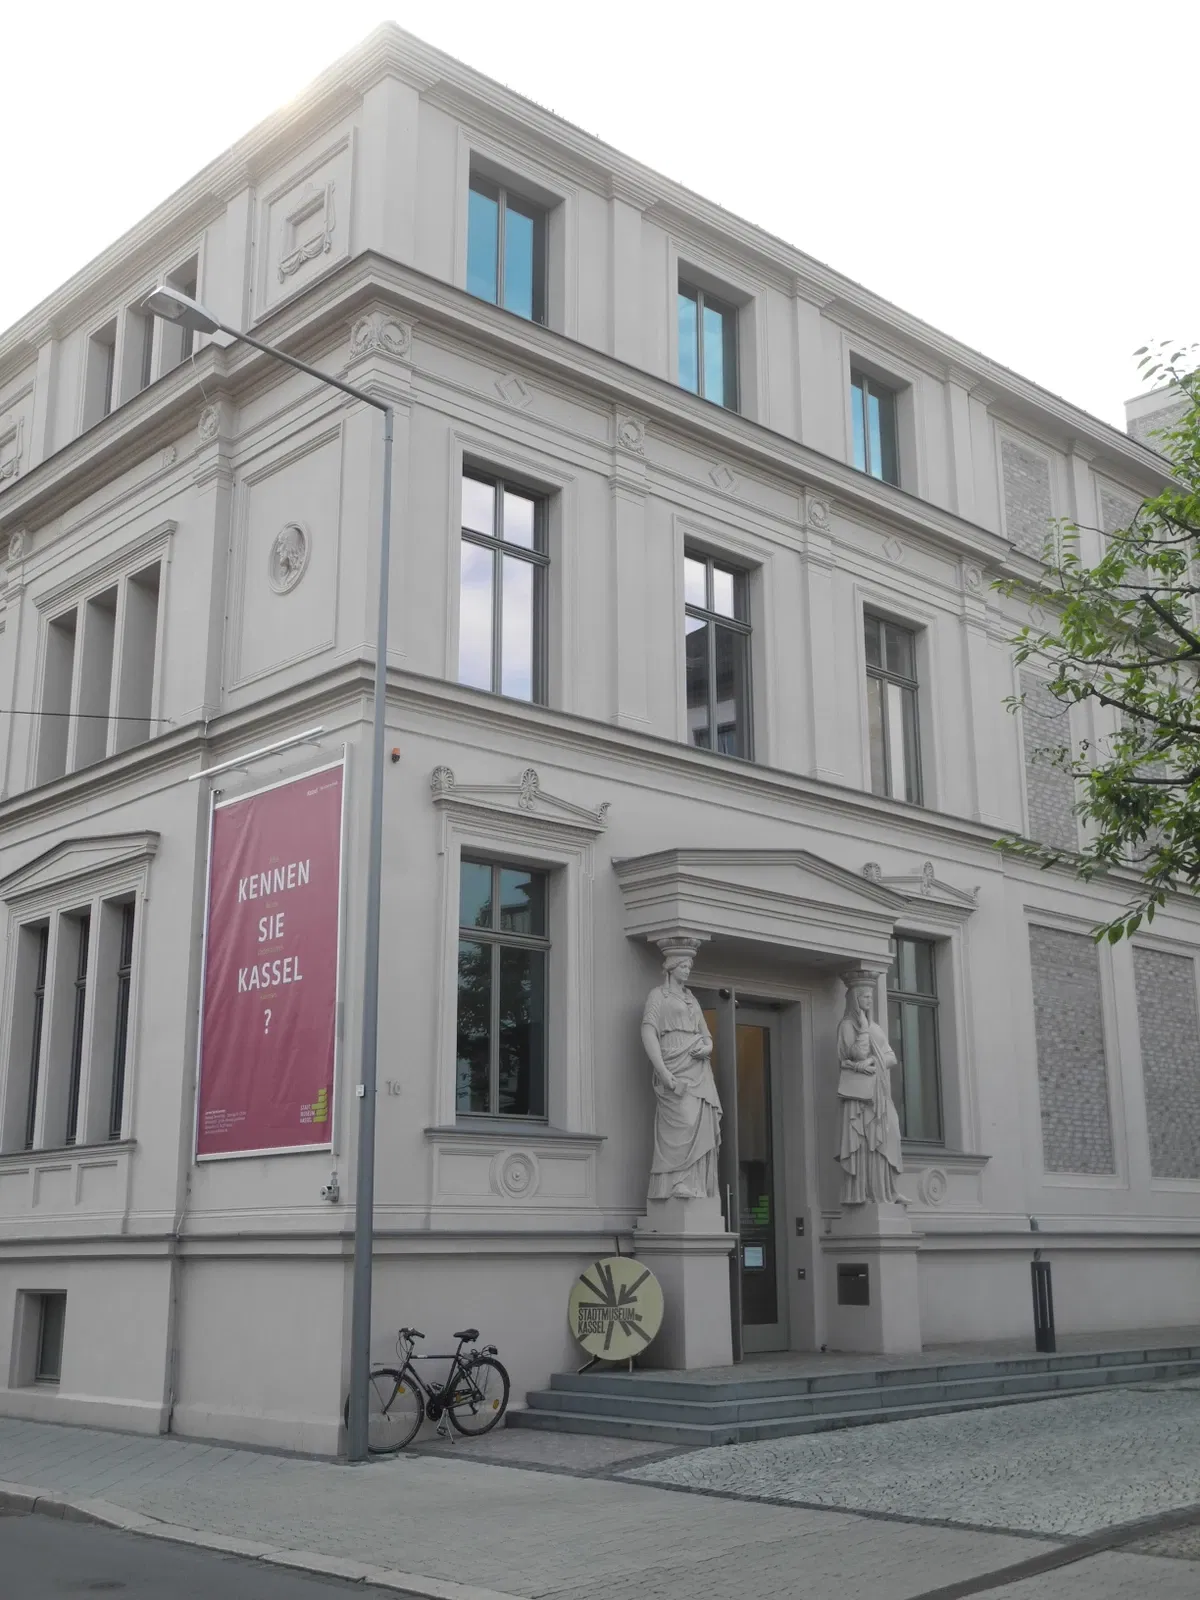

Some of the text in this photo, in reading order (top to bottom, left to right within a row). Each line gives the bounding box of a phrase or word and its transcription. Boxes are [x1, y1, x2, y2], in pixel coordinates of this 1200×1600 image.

[238, 859, 310, 903] KENNEN
[258, 912, 285, 942] SIE
[238, 955, 303, 993] KASSEL
[264, 1009, 272, 1034] ?
[577, 1320, 606, 1334] KASSEL
[578, 1307, 635, 1321] STADTMUSEUM
